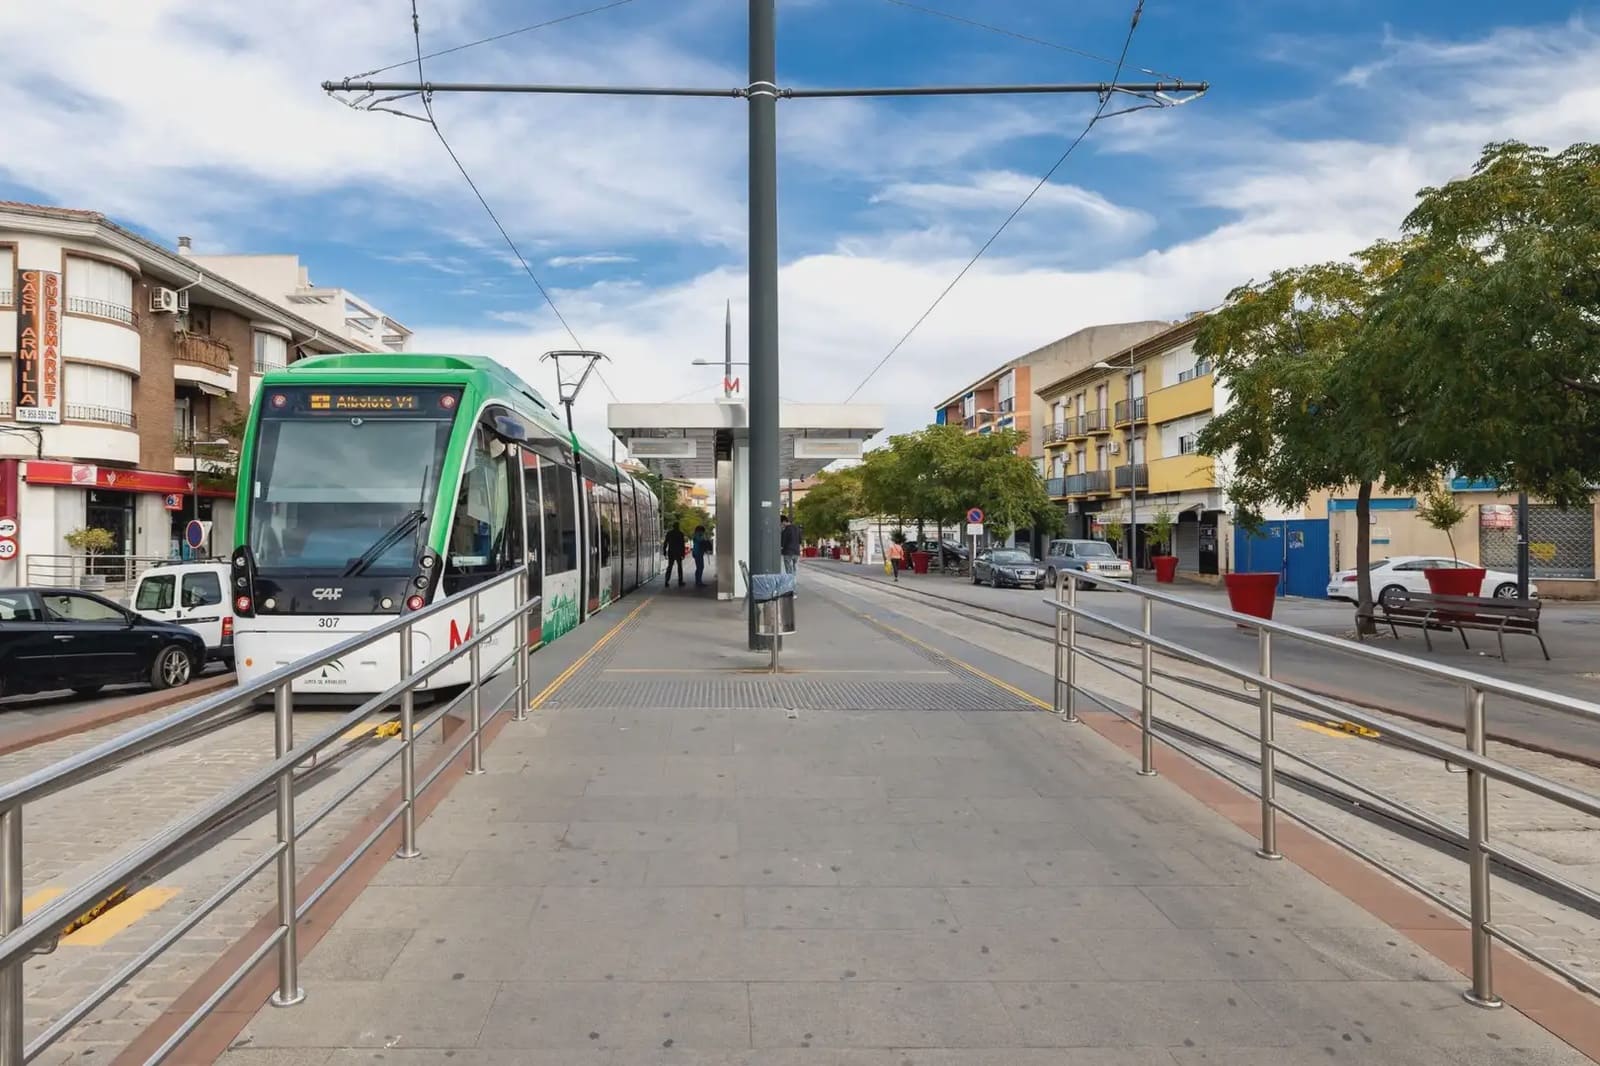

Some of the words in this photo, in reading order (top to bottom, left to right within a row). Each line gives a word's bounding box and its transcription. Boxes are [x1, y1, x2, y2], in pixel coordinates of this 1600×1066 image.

[22, 271, 37, 316] CASH
[44, 273, 59, 408] SUPERMARKET
[20, 327, 38, 406] ARMILLA
[724, 376, 740, 393] M
[396, 395, 413, 408] V1
[0, 544, 14, 553] 30
[311, 587, 343, 601] CAF
[318, 617, 340, 628] 307
